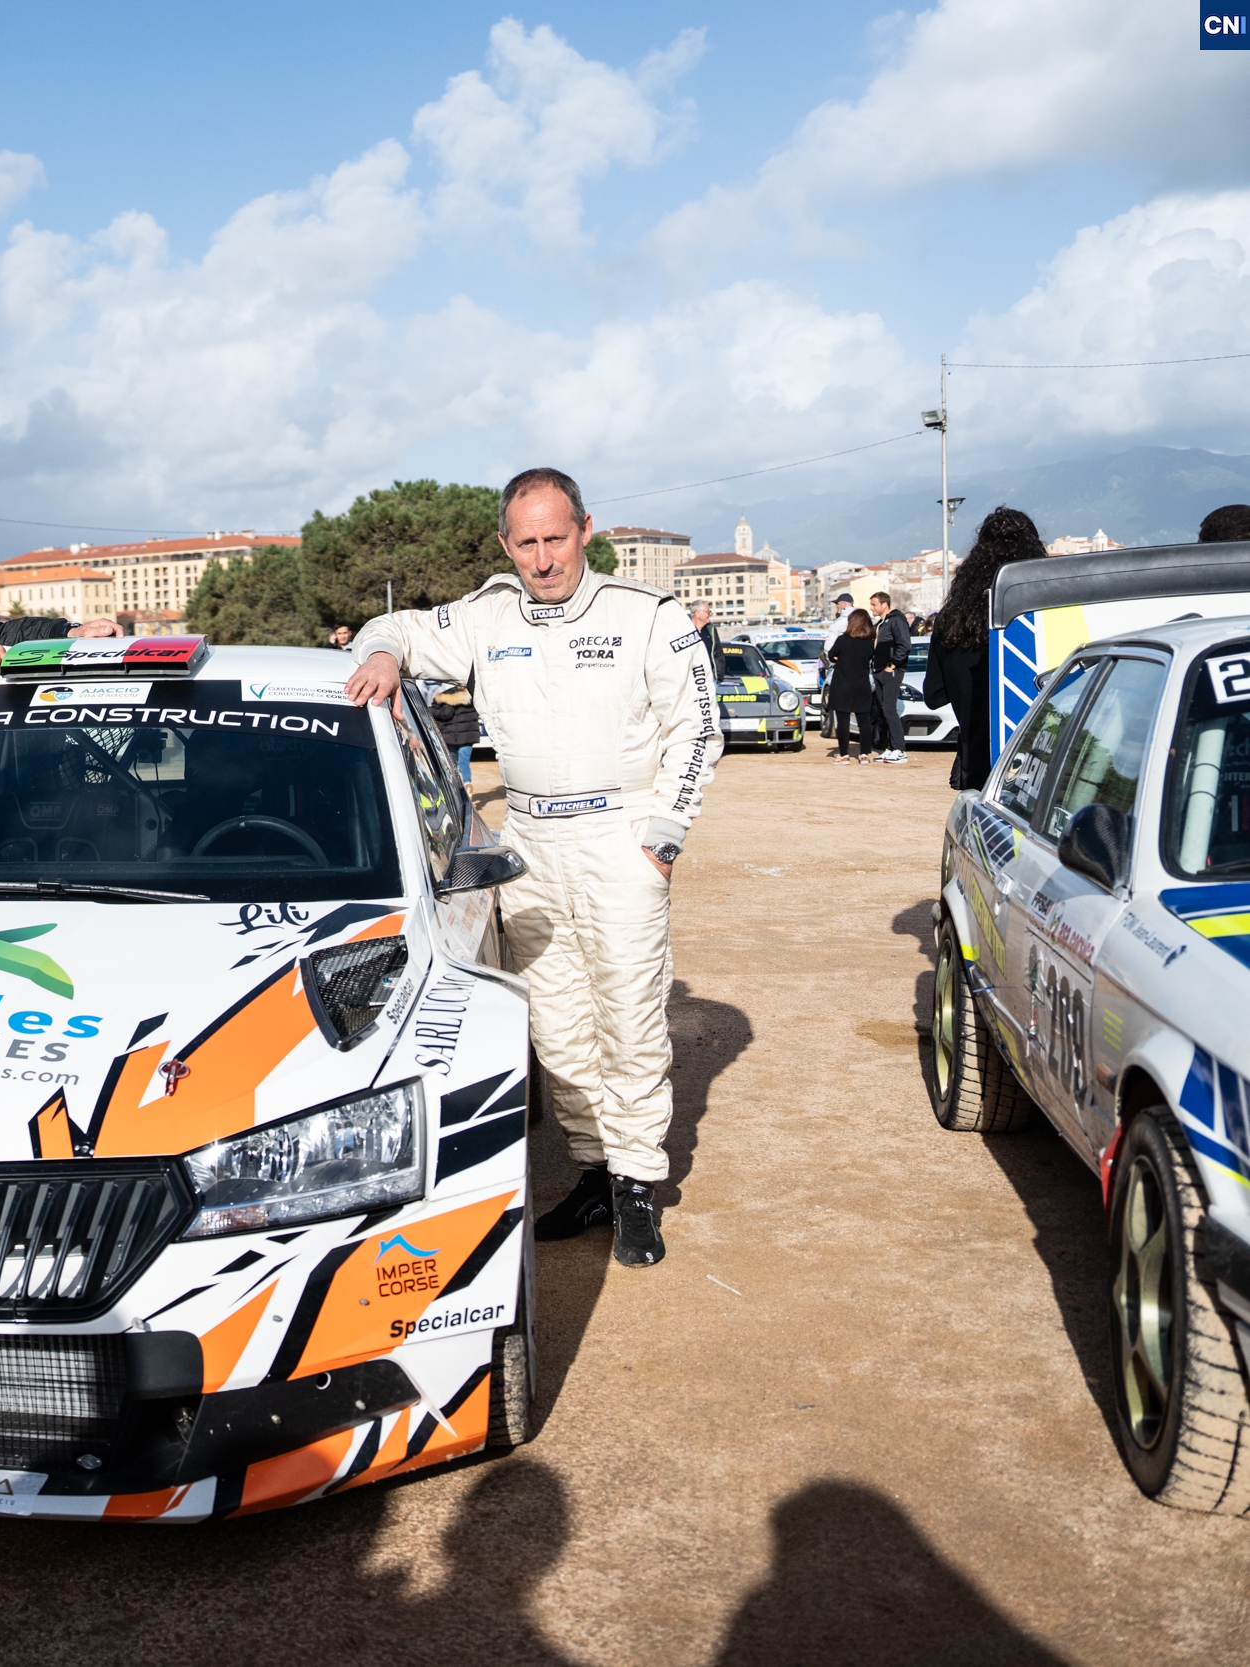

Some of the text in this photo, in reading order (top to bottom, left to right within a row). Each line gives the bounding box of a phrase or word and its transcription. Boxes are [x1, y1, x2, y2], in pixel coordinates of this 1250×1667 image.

[569, 637, 610, 648] ORECA
[52, 650, 187, 661] Specialcar
[24, 706, 340, 737] CONSTRUCTION
[550, 797, 605, 812] MICHELIN
[414, 1016, 465, 1078] SARL
[376, 1258, 437, 1281] IMPER
[378, 1275, 440, 1297] CORSE
[389, 1304, 506, 1339] Specialcar
